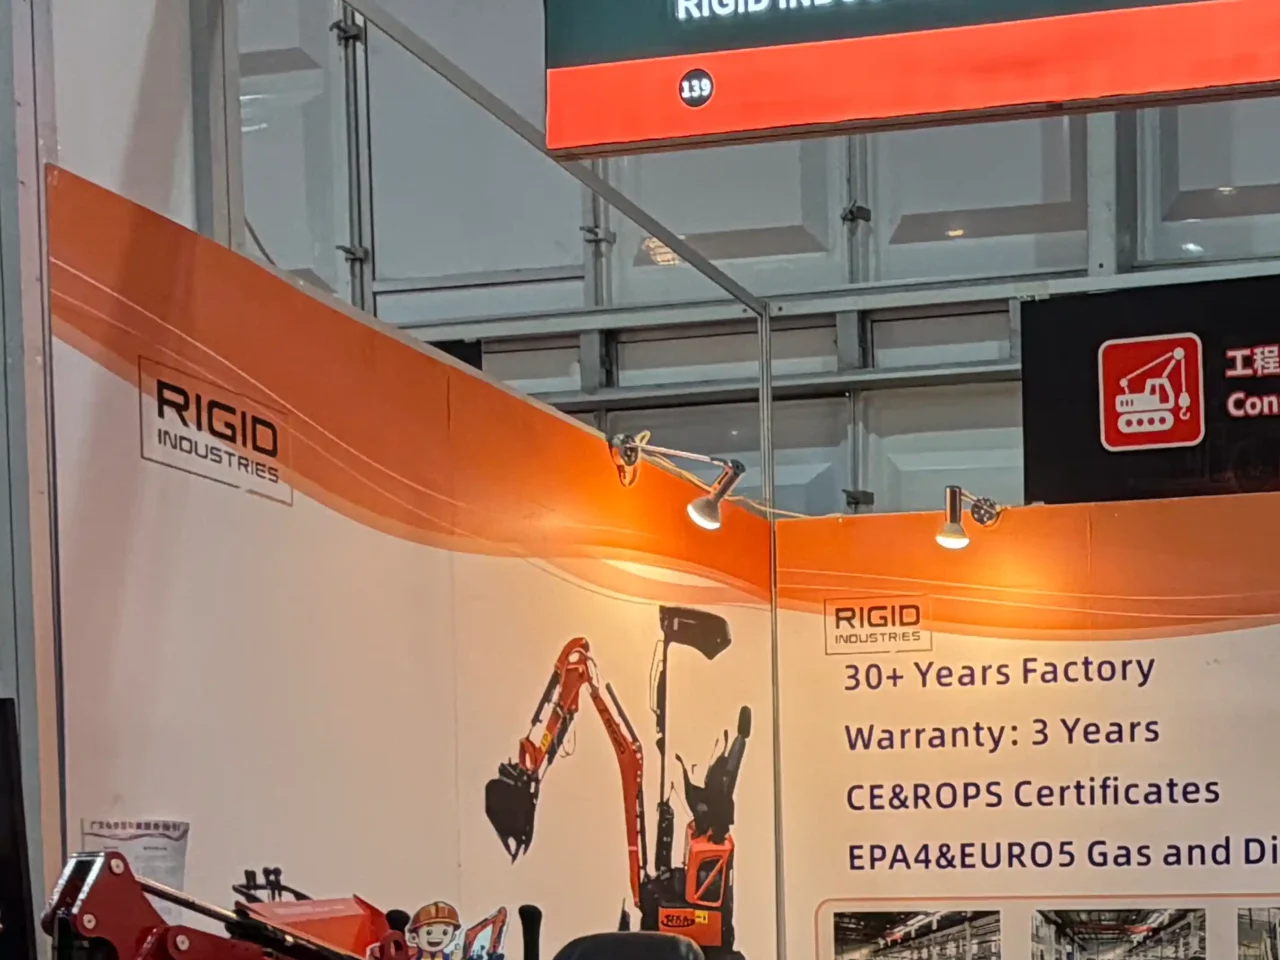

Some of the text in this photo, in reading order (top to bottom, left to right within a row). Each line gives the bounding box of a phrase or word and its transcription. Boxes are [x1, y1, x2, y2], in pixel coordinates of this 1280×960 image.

[681, 77, 711, 99] 139
[157, 378, 279, 458] RIGID
[157, 428, 280, 484] INDUSTRIES
[834, 604, 920, 629] RIGID
[835, 630, 921, 645] INDUSTRIES
[844, 655, 1156, 691] 30+ Years Factory
[845, 717, 1160, 753] Warranty: 3 Years
[846, 776, 1220, 811] CE&ROPS Certificates
[848, 841, 1076, 871] EPA4&EURO5
[1087, 840, 1152, 867] Gas
[1163, 836, 1231, 866] and
